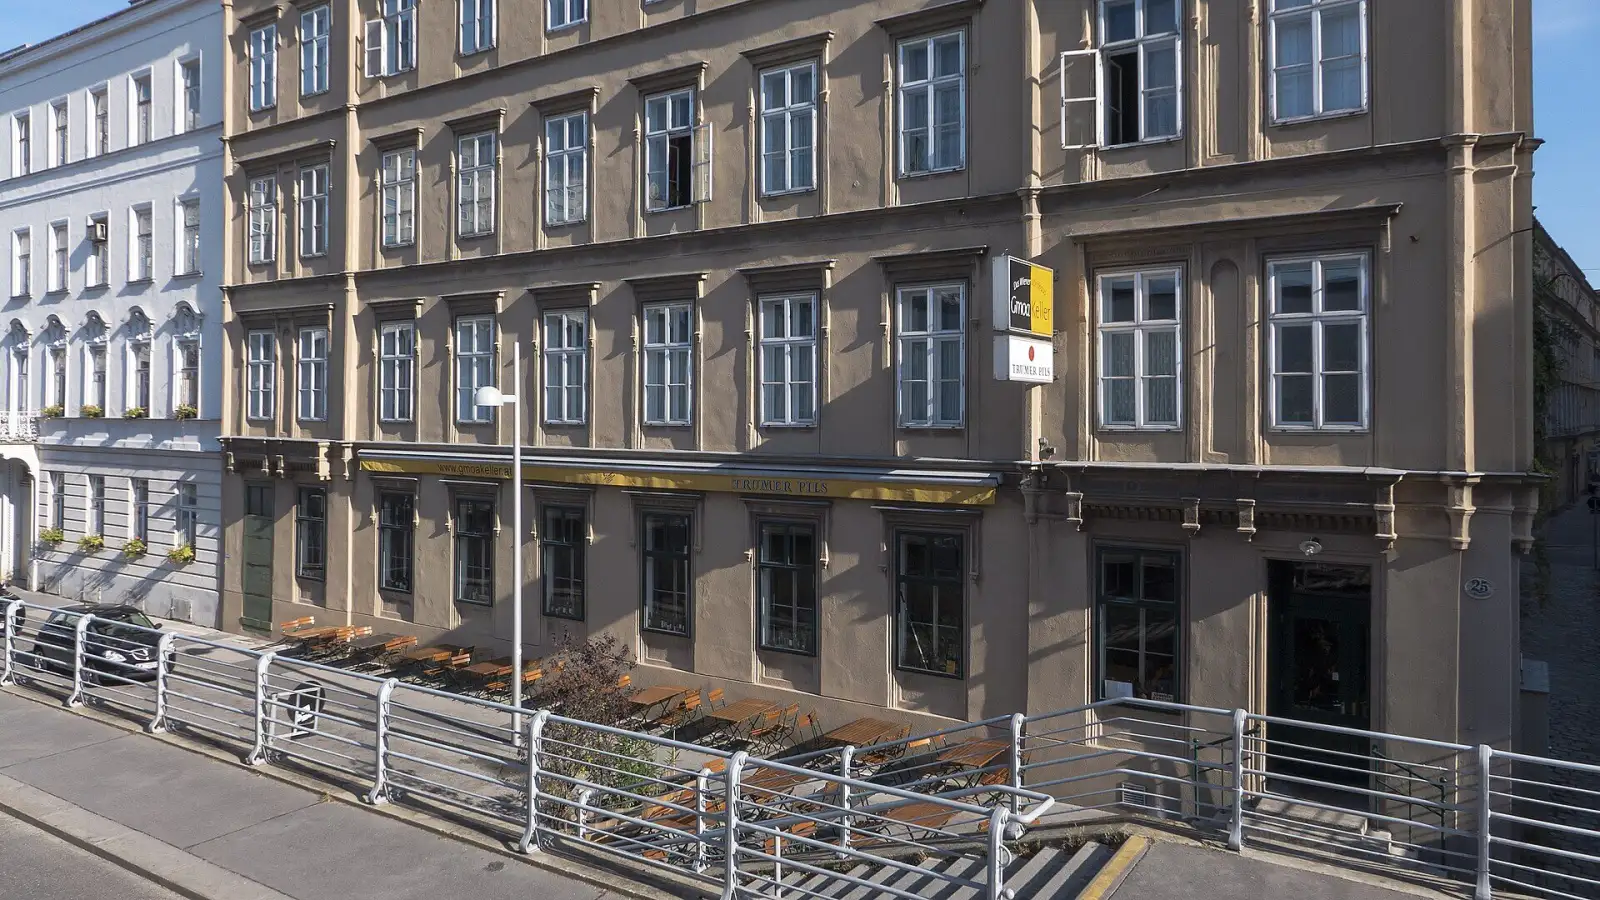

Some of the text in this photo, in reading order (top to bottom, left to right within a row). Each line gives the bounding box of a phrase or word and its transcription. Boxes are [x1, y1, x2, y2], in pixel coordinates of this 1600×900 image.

[1012, 363, 1051, 377] TRUMER PILS
[437, 464, 512, 476] www.gmoakeller.at
[733, 479, 828, 493] TRUMER PILS
[1471, 579, 1489, 594] 25
